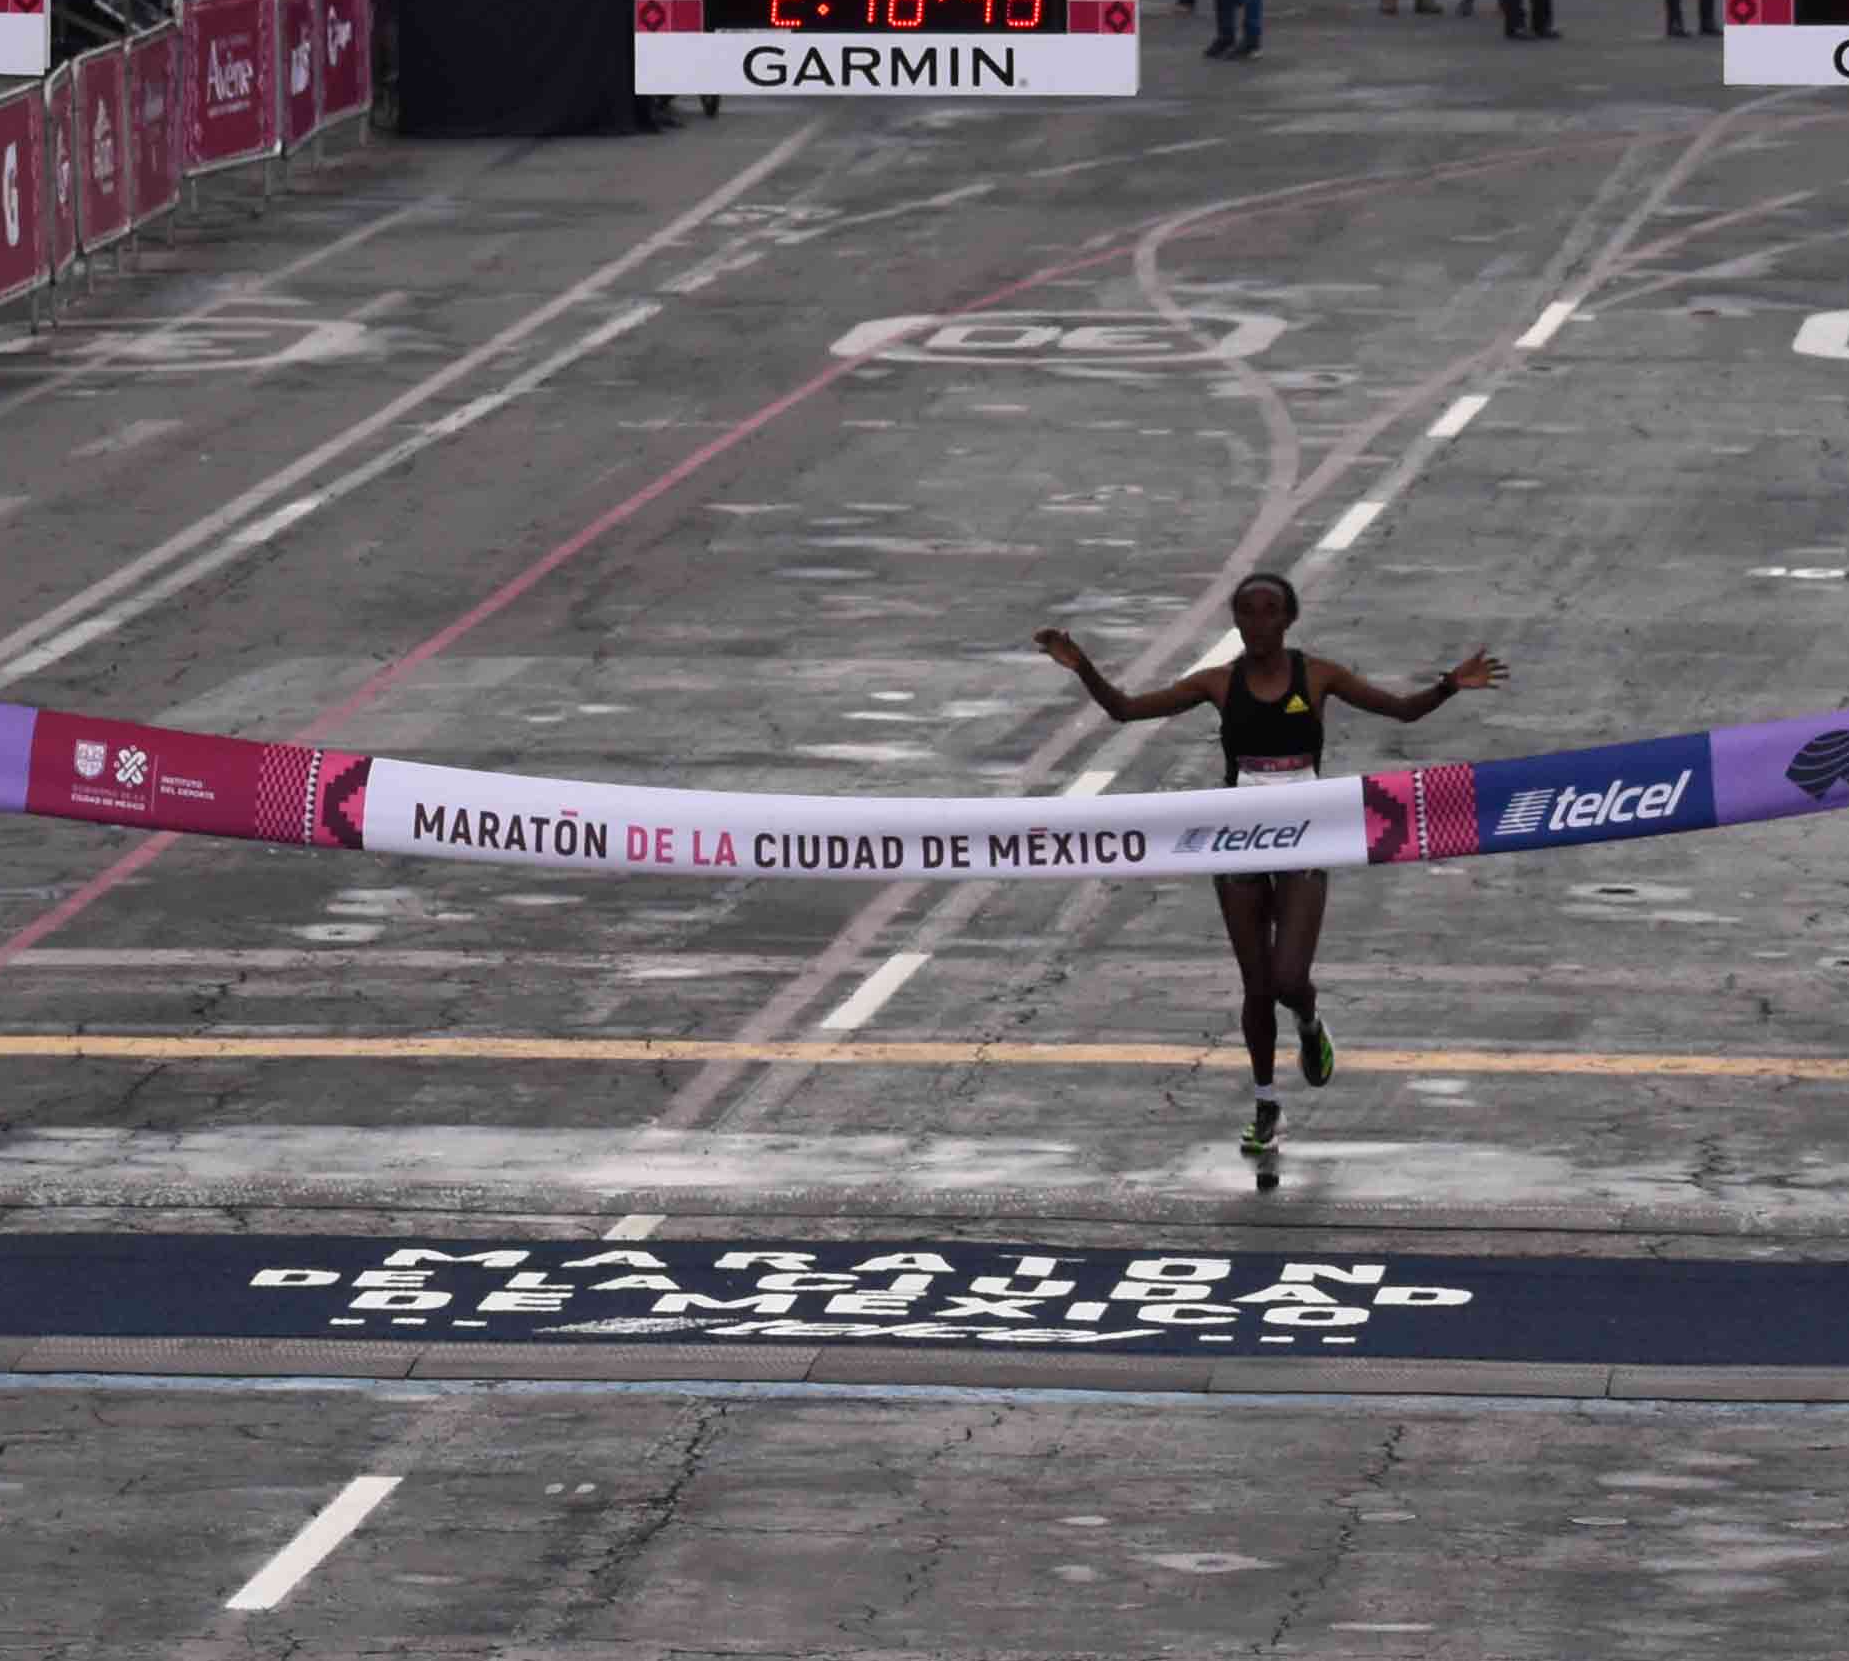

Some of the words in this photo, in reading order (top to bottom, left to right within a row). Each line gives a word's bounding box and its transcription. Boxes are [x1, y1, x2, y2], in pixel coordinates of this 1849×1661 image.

[742, 45, 1015, 88] GARMIN
[1549, 770, 1692, 830] telcel
[626, 825, 674, 864] DE
[692, 830, 738, 867] LA
[754, 832, 904, 870] CIUDAD
[922, 834, 971, 870] DE
[1209, 819, 1310, 852] telcel
[249, 1269, 434, 1288] DE
[504, 1271, 681, 1291] LA
[756, 1271, 1473, 1306] CIUDAD
[349, 1290, 573, 1313] DE
